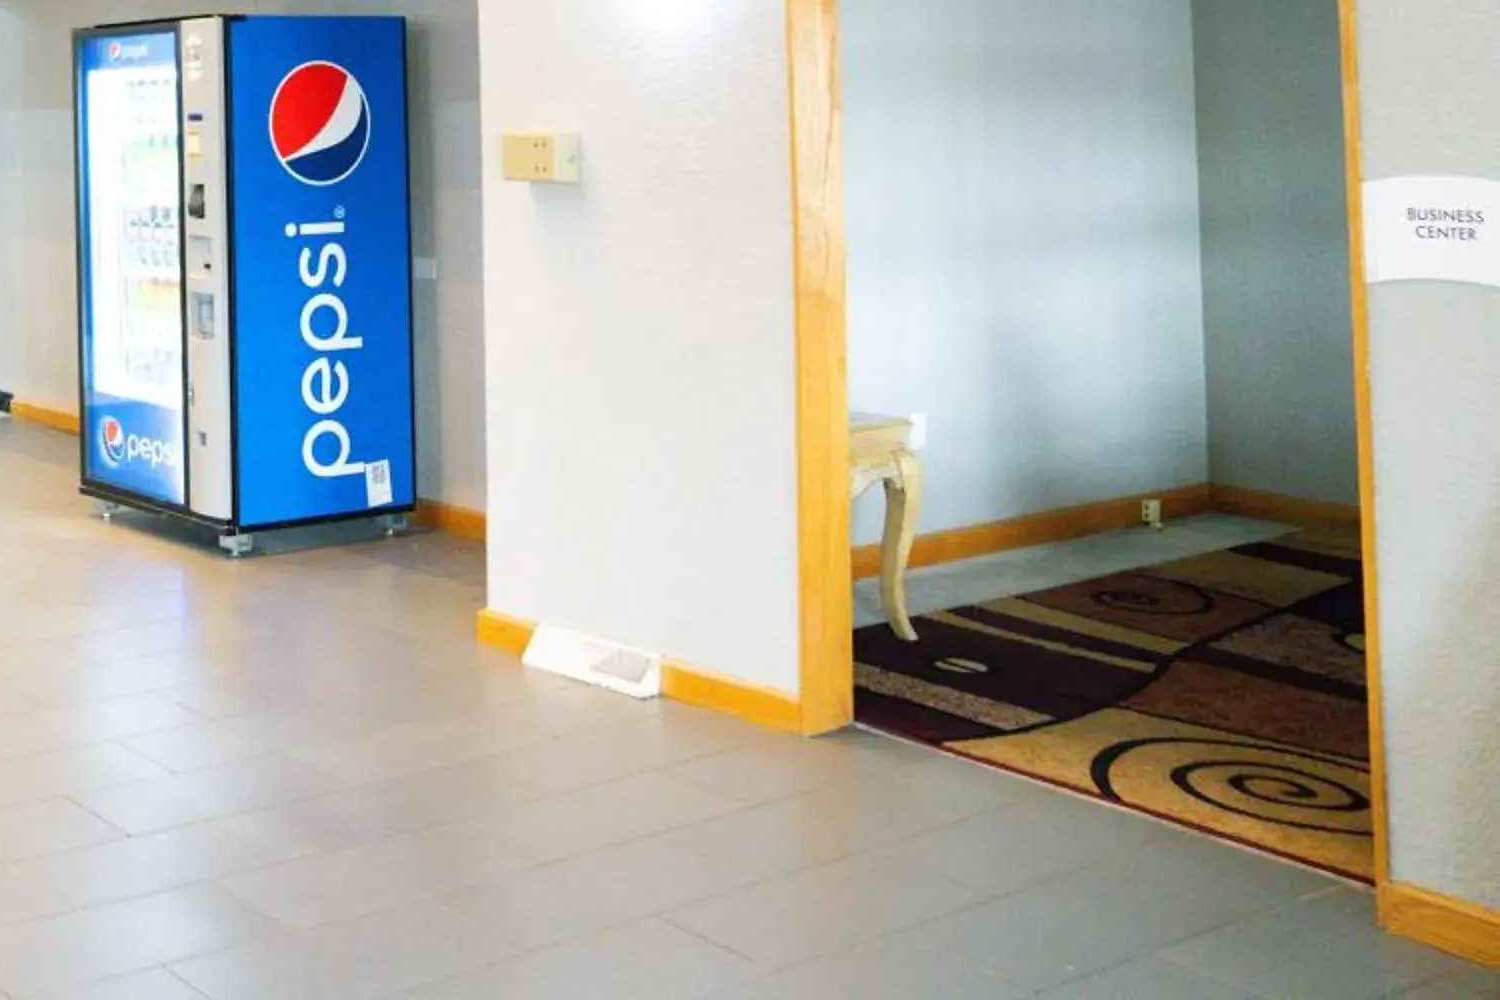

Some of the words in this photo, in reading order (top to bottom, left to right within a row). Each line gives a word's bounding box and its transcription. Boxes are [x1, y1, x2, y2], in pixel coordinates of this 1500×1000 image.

[1407, 207, 1485, 224] BUSINESS
[1415, 225, 1477, 241] CENTER
[285, 221, 366, 478] pepsi
[127, 433, 177, 469] peps
